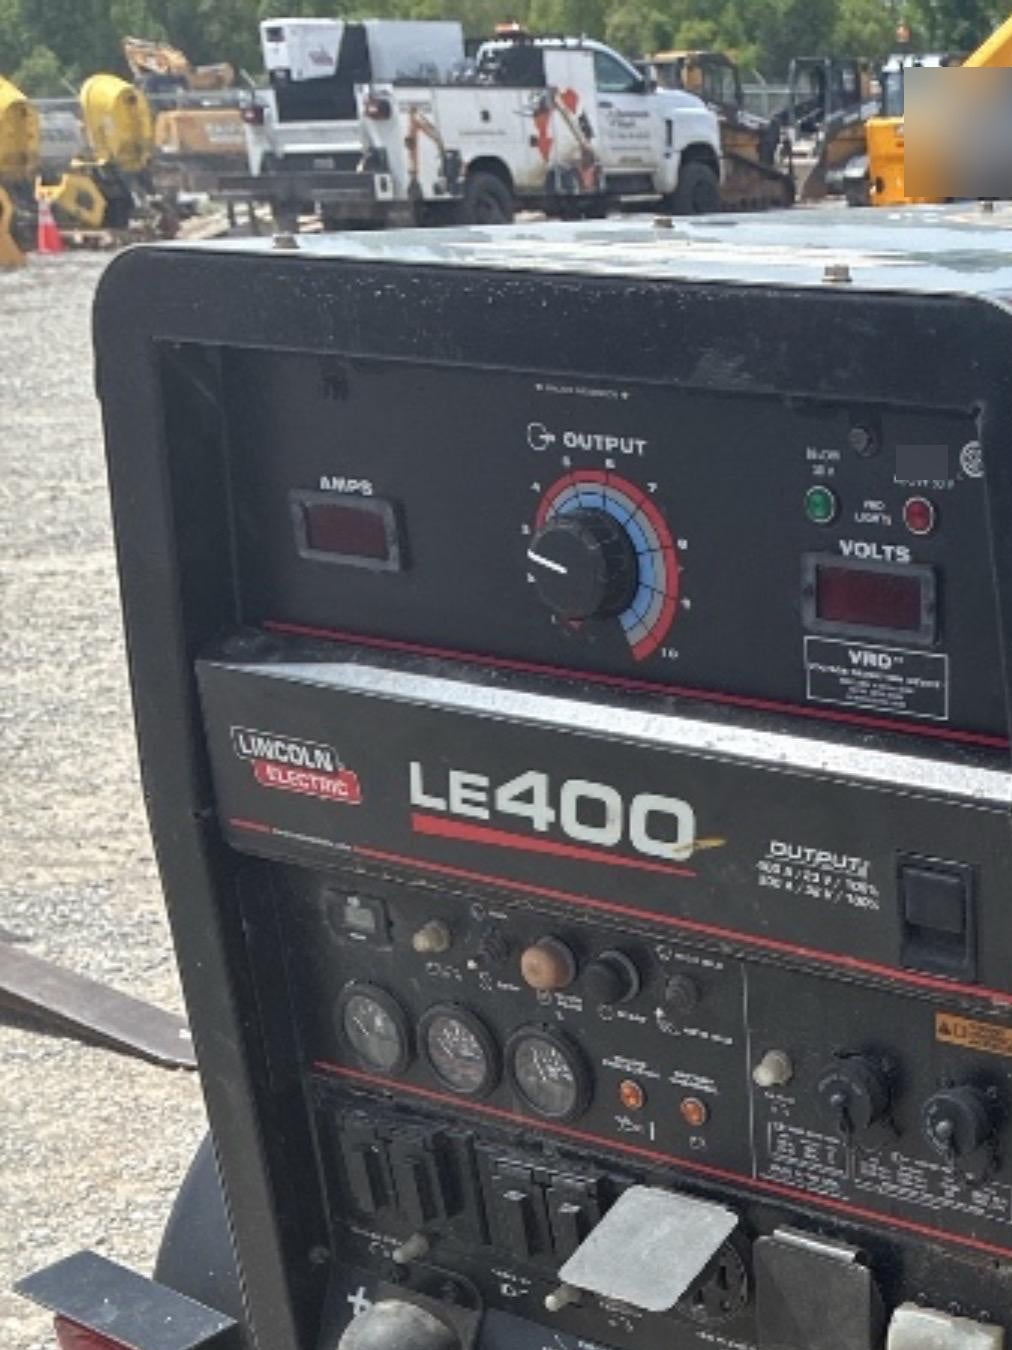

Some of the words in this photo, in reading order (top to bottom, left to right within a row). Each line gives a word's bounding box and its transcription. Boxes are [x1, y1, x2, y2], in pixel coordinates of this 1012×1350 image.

[563, 431, 647, 455] OUTPUT
[320, 476, 373, 496] AMPS
[839, 539, 911, 563] VOLTS
[238, 733, 334, 772] LINCOLN
[265, 764, 350, 796] ELECTRIC
[408, 761, 697, 862] LE400
